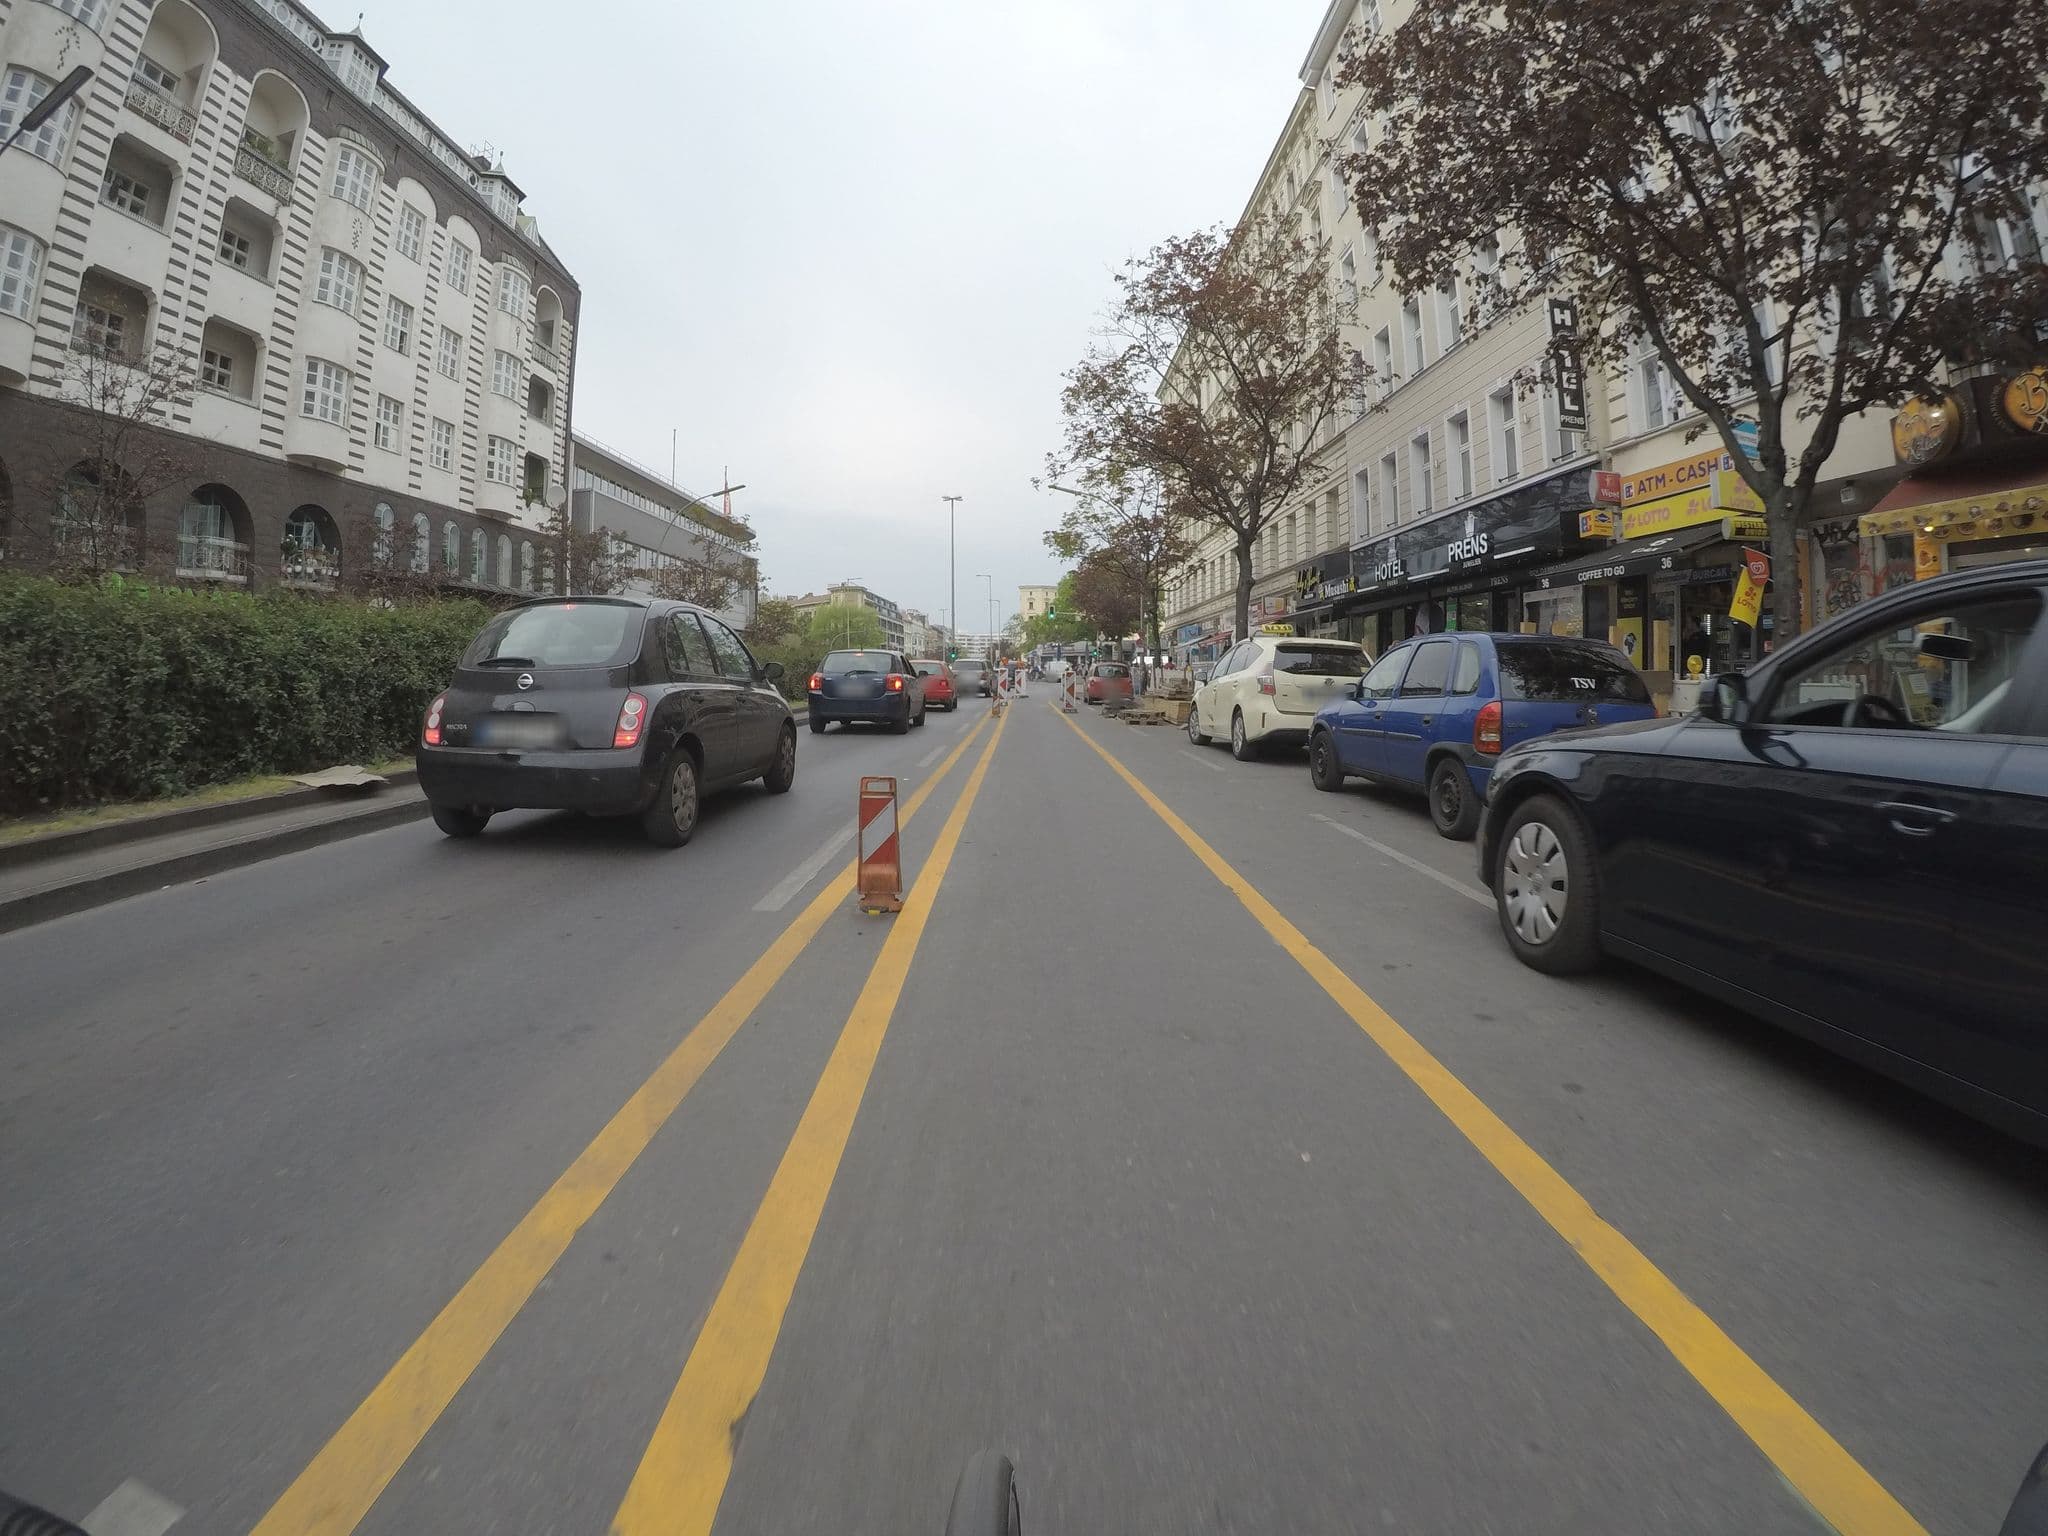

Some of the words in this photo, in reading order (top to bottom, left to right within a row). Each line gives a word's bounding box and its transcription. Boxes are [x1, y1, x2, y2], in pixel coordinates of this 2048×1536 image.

[1553, 308, 1579, 411] HTEL
[1560, 414, 1585, 425] PRENS
[1637, 472, 1666, 496] ATM
[1676, 457, 1719, 483] CASH
[1600, 488, 1620, 499] West
[1637, 507, 1670, 527] LOTTO
[1448, 533, 1488, 562] PRENS
[1375, 559, 1404, 581] HOTEL
[1661, 557, 1672, 570] 36
[1578, 568, 1602, 582] COFFEE
[1603, 568, 1612, 577] TO
[1614, 565, 1625, 576] GO
[1541, 578, 1550, 588] 36
[1737, 596, 1757, 614] LOTTO
[1571, 677, 1596, 689] TSV
